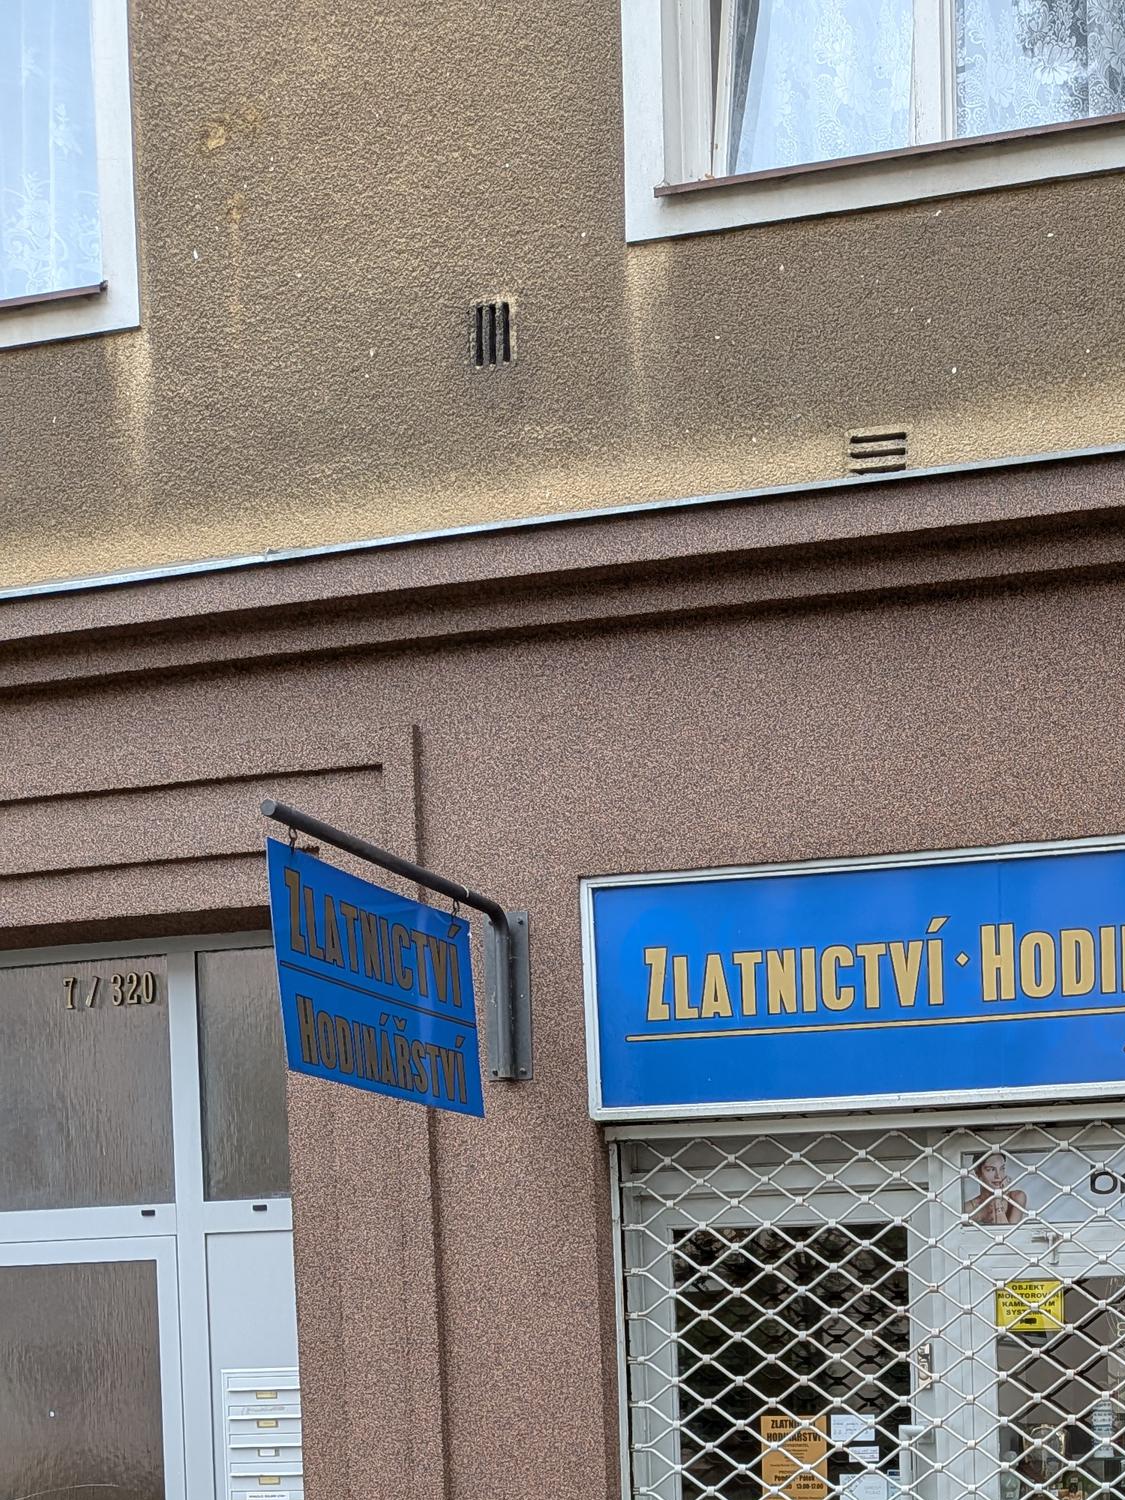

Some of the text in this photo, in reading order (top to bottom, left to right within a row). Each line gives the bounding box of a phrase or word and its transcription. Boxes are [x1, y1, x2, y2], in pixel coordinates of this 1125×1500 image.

[283, 866, 463, 1009] ZLATNICTVÍ
[643, 915, 951, 1024] ZLATNICTVÍ
[295, 993, 469, 1105] HODINÁŘSTVÍ
